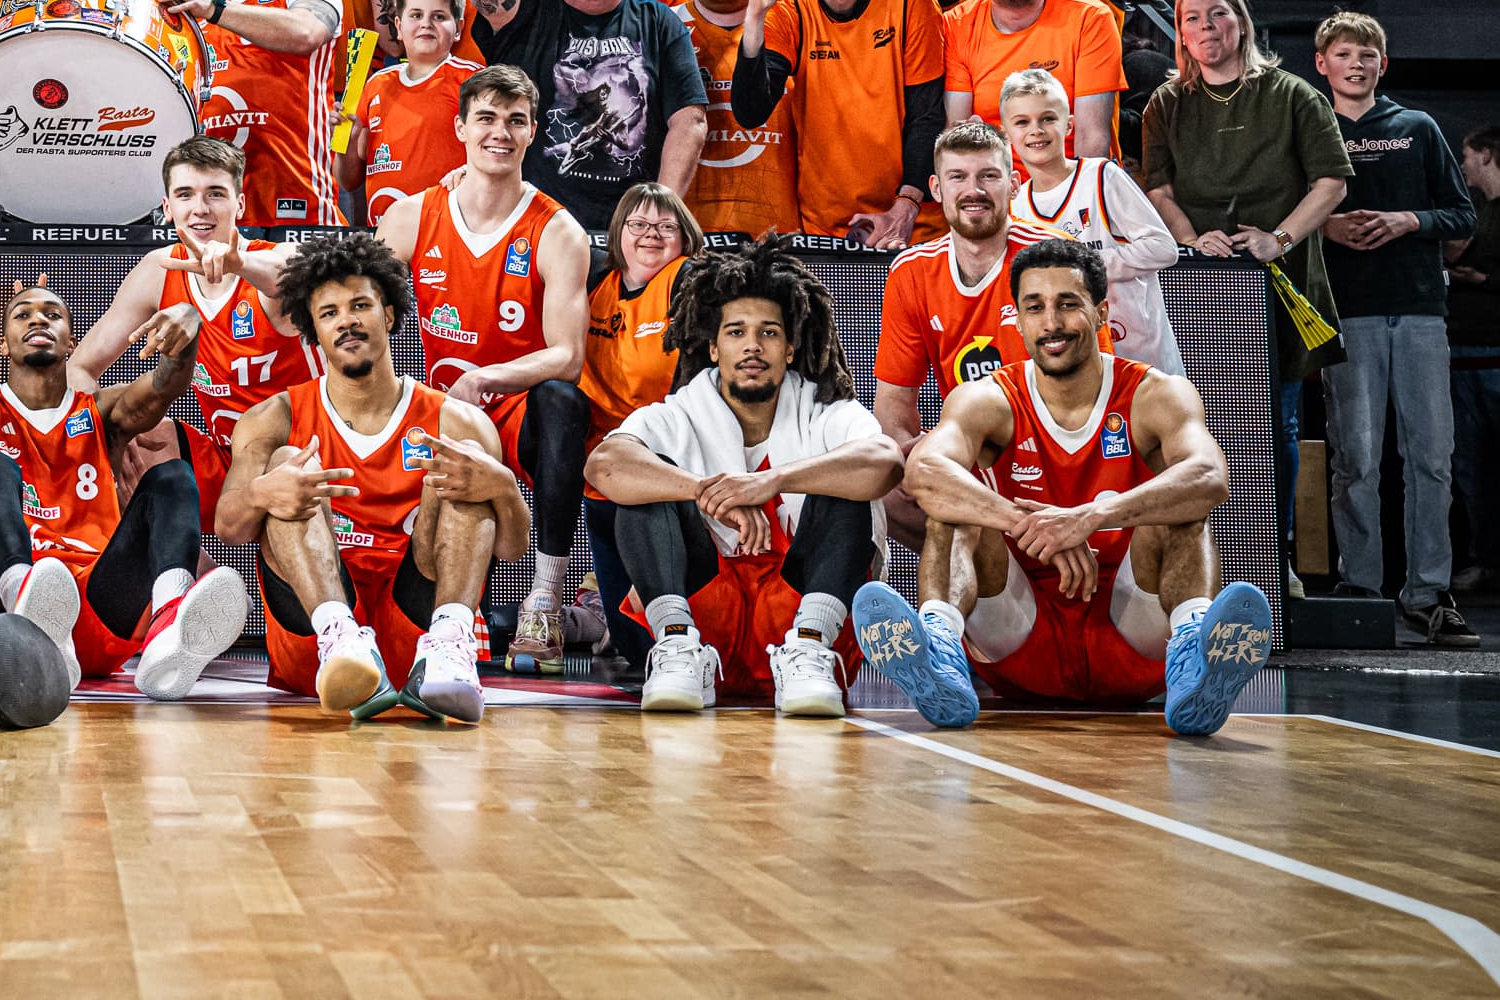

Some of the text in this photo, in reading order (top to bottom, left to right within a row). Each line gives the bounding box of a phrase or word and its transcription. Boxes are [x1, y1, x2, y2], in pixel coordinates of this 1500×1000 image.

[33, 105, 152, 132] KLETT Rasta
[203, 112, 269, 130] MIAVIT
[31, 131, 157, 148] VERSCHLUSS
[16, 147, 35, 155] DER
[36, 147, 66, 156] RASTA
[67, 148, 127, 157] SUPPORTERS
[32, 227, 125, 241] REEFUEL
[419, 268, 446, 282] Rasta
[507, 263, 526, 275] BBL
[498, 301, 526, 333] 9
[234, 325, 252, 338] BBL
[230, 350, 278, 387] 17
[69, 419, 93, 436] BBL
[1105, 443, 1127, 455] BBL
[1011, 462, 1043, 476] Rasta
[76, 463, 100, 501] 8
[861, 615, 914, 647] NOT FROM
[1209, 621, 1269, 644] NOT FROM
[870, 635, 921, 668] HERE
[1207, 640, 1264, 665] HERE
